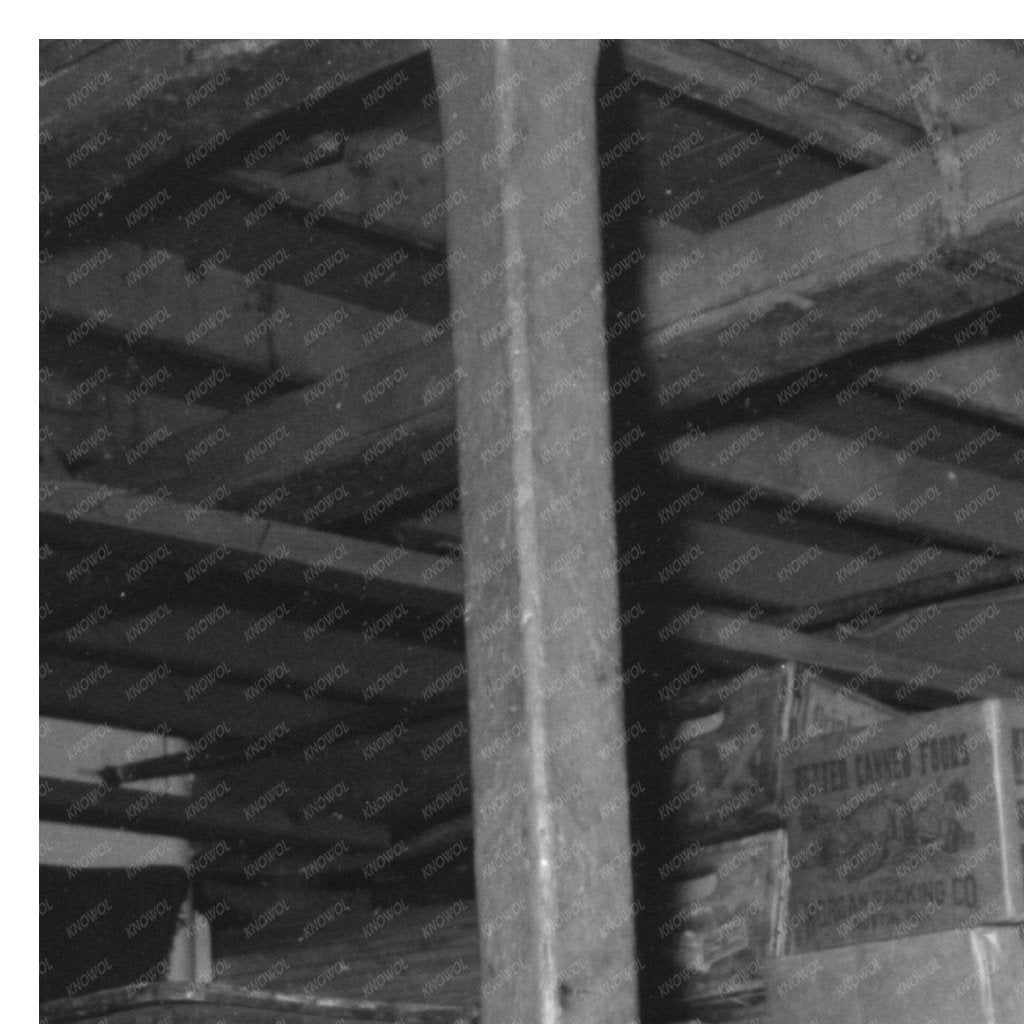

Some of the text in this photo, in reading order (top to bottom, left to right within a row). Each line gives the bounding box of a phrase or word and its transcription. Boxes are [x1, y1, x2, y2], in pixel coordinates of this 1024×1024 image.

[854, 745, 911, 787] CANNED
[919, 732, 970, 776] FOODS
[872, 880, 946, 908] PACKING
